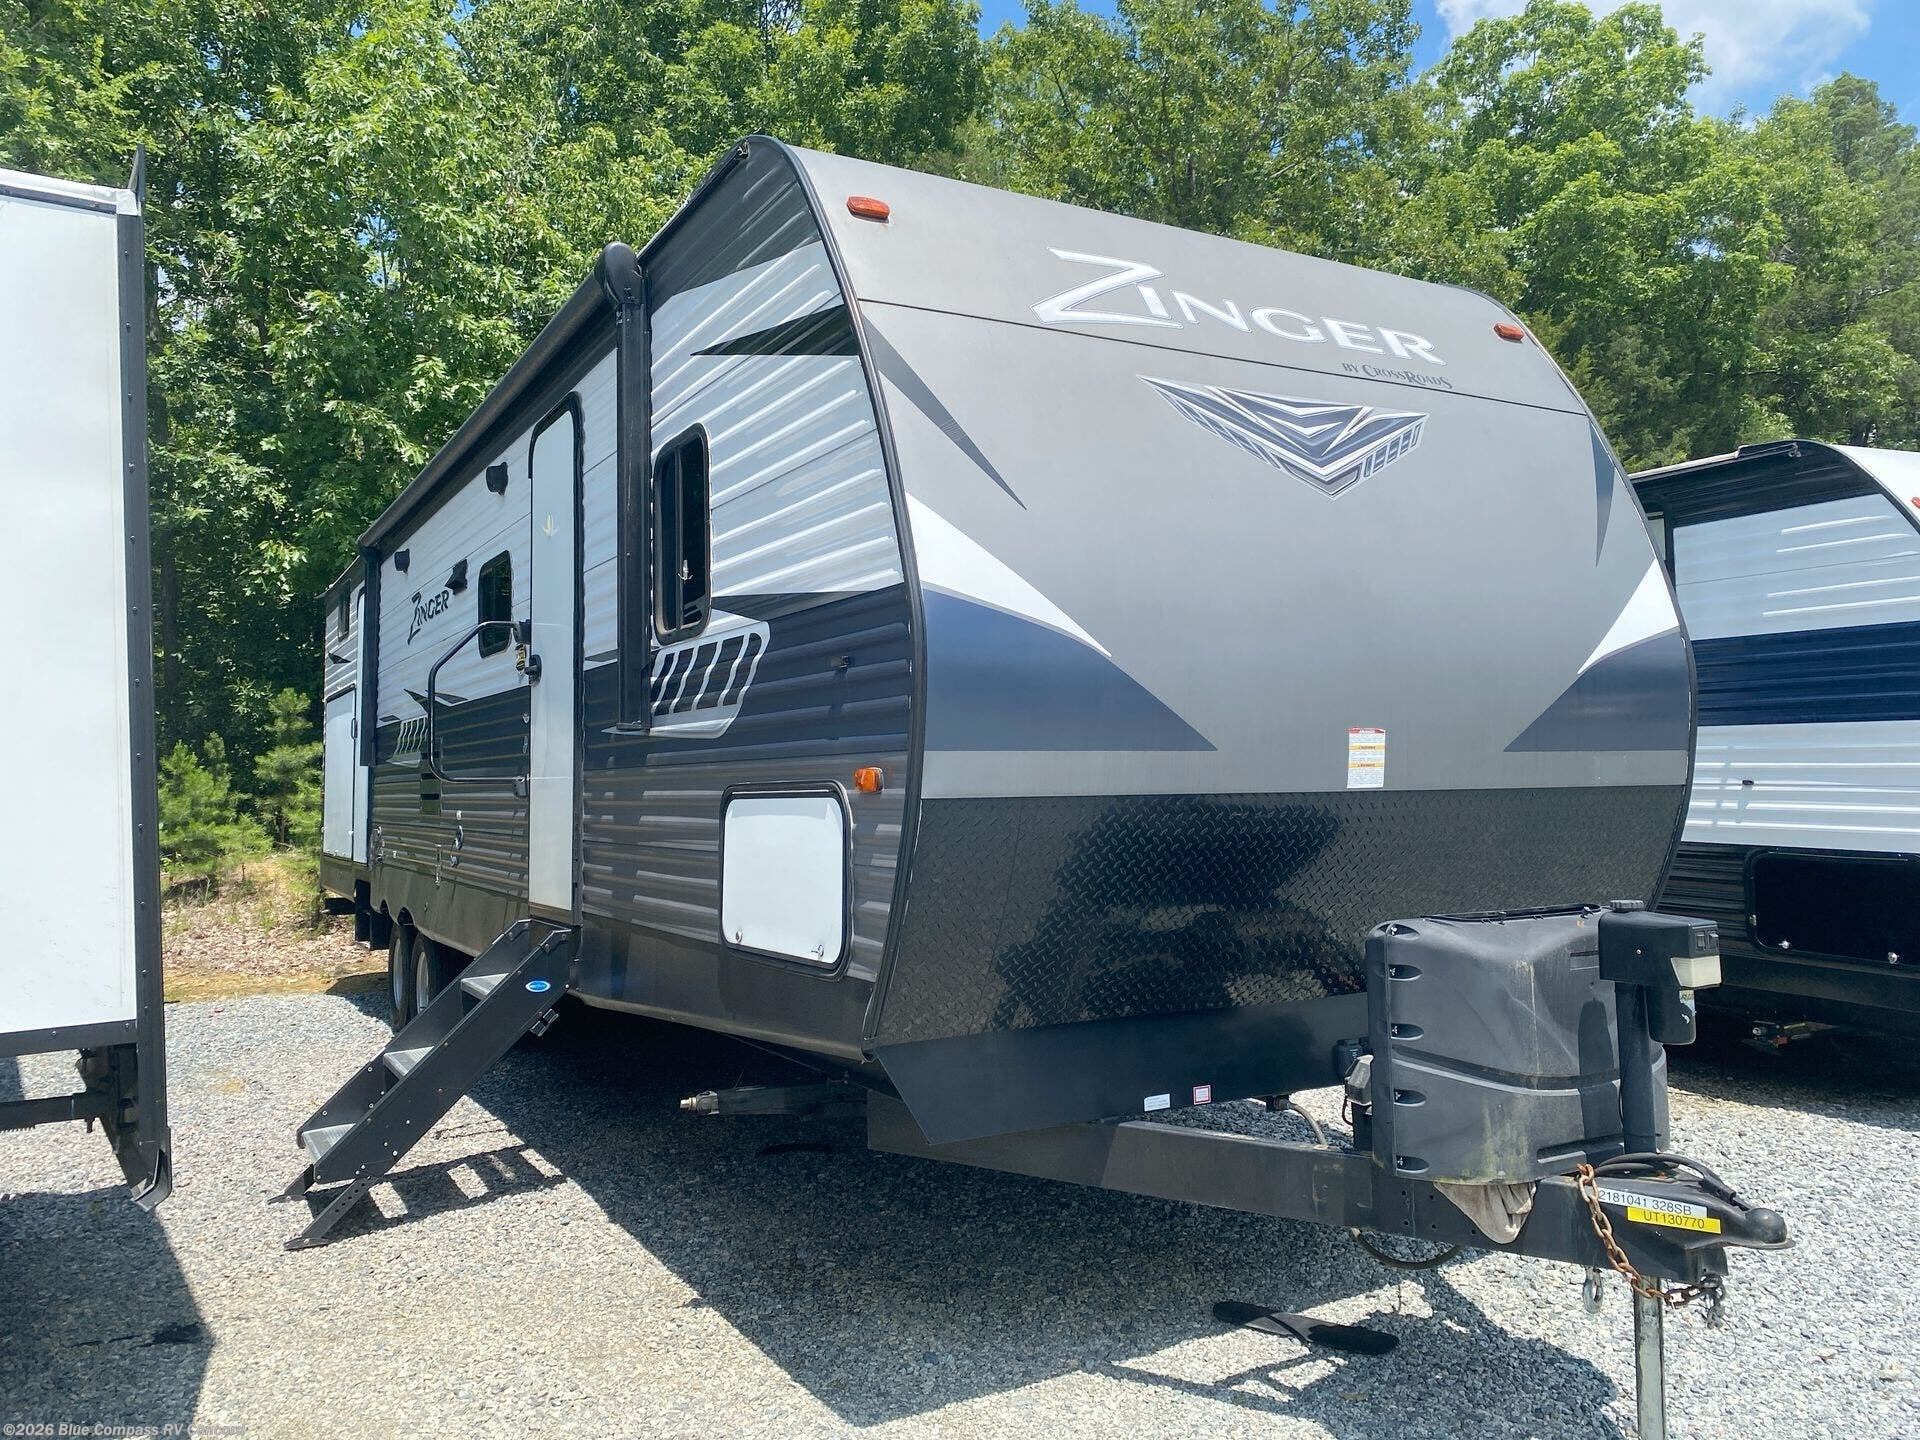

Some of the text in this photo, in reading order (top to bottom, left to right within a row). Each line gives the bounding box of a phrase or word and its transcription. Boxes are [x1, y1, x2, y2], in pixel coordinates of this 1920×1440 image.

[1030, 246, 1447, 366] ZINGER
[1341, 362, 1358, 373] BY
[407, 589, 450, 646] ZINGER
[1599, 1189, 1692, 1216] 2181041 328SB
[1643, 1210, 1705, 1229] UT130770
